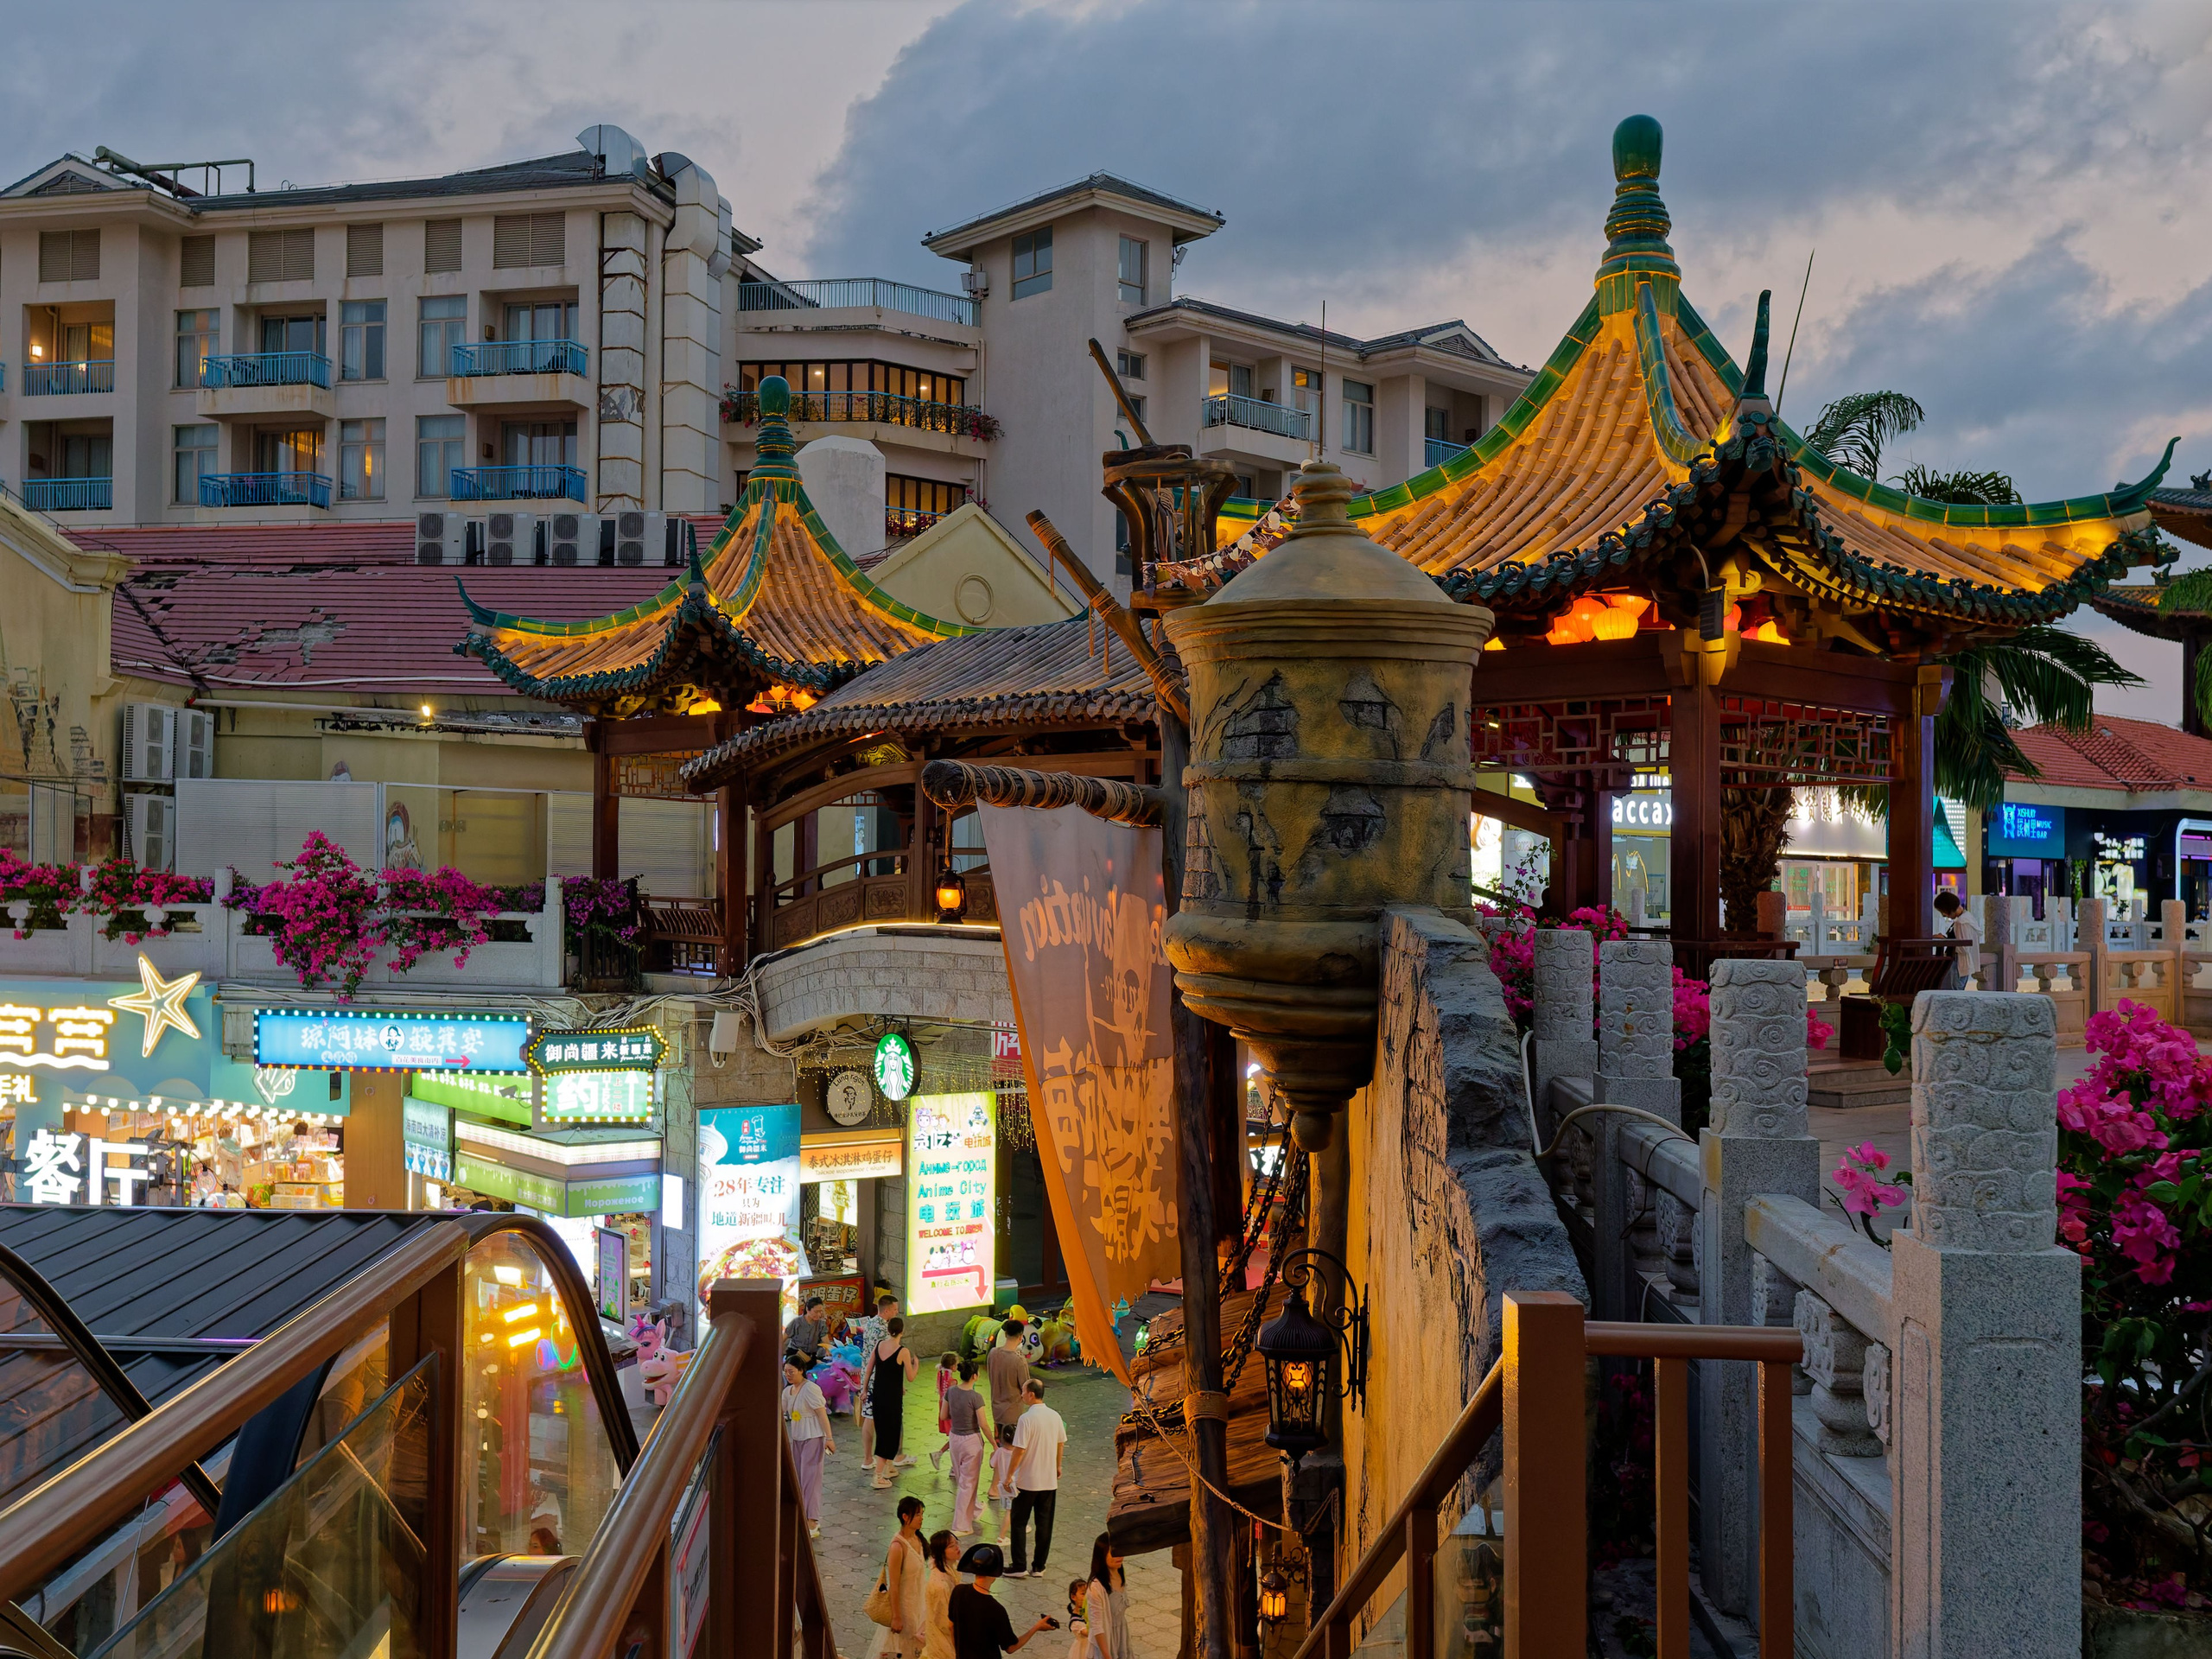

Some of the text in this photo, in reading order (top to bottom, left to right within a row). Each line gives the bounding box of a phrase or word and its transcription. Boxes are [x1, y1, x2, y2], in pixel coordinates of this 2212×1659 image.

[2037, 820, 2052, 830] MUSIC
[2037, 830, 2047, 839] BAR
[613, 1072, 623, 1112] 上二楼
[964, 1135, 992, 1148] 电玩城
[24, 1128, 149, 1206] 餐厅
[808, 1150, 893, 1169] 泰式冰淇淋鸡蛋仔
[918, 1159, 988, 1176] Аниме-город
[918, 1179, 987, 1198] Anime City
[584, 1195, 645, 1209] Мороженое
[918, 1198, 986, 1224] 电玩城
[918, 1228, 953, 1239] WELCOME
[956, 1225, 964, 1236] TO
